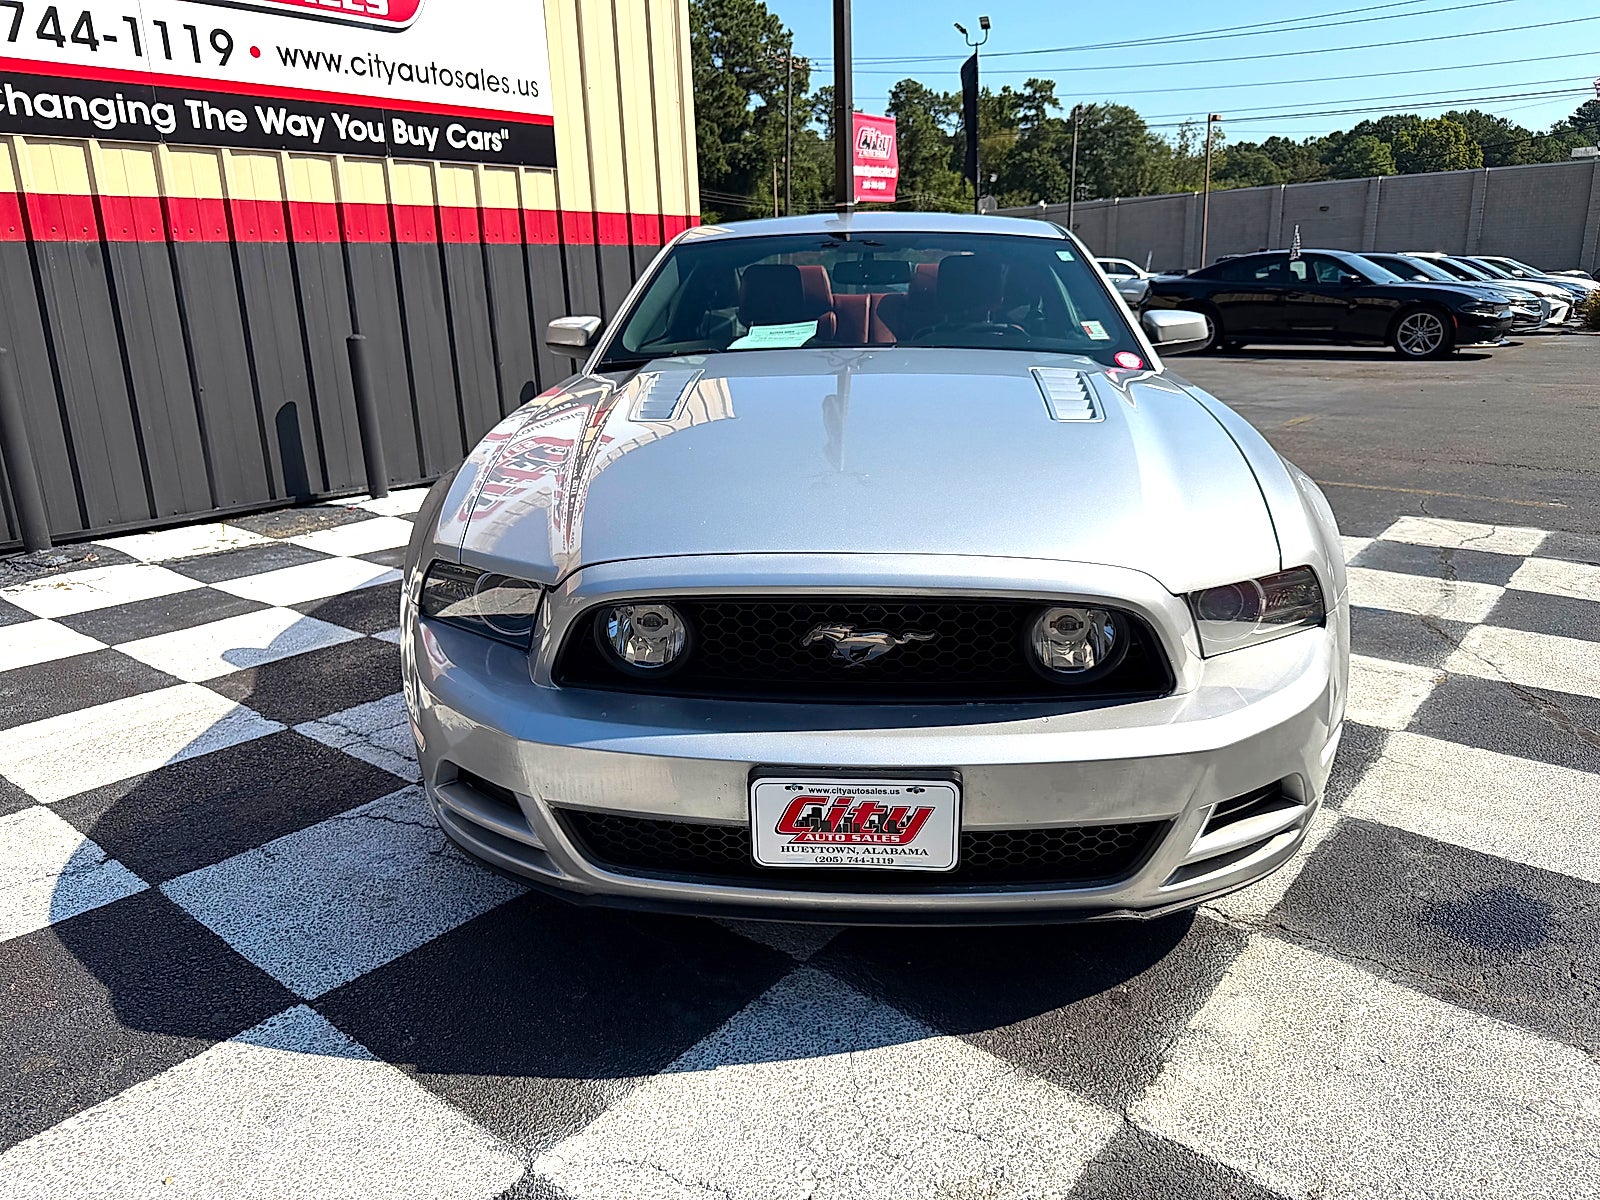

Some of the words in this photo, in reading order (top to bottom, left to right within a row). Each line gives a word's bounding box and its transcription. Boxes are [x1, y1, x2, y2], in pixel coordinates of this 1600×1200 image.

[0, 0, 233, 66] 744-1119
[276, 46, 539, 97] www.cityautosales.us
[184, 99, 248, 132] The
[255, 106, 325, 143] Way
[331, 112, 385, 143] You
[392, 118, 439, 151] Buy
[446, 123, 509, 152] Cars"
[808, 786, 900, 795] www.cityautosales.us
[774, 795, 936, 846] City
[803, 833, 846, 842] AUTO
[851, 834, 900, 843] SALES
[780, 845, 860, 855] HUEYTOWN,
[862, 847, 929, 856] ALABAMA
[814, 856, 844, 864] (205)
[847, 856, 895, 865] 744-1119
